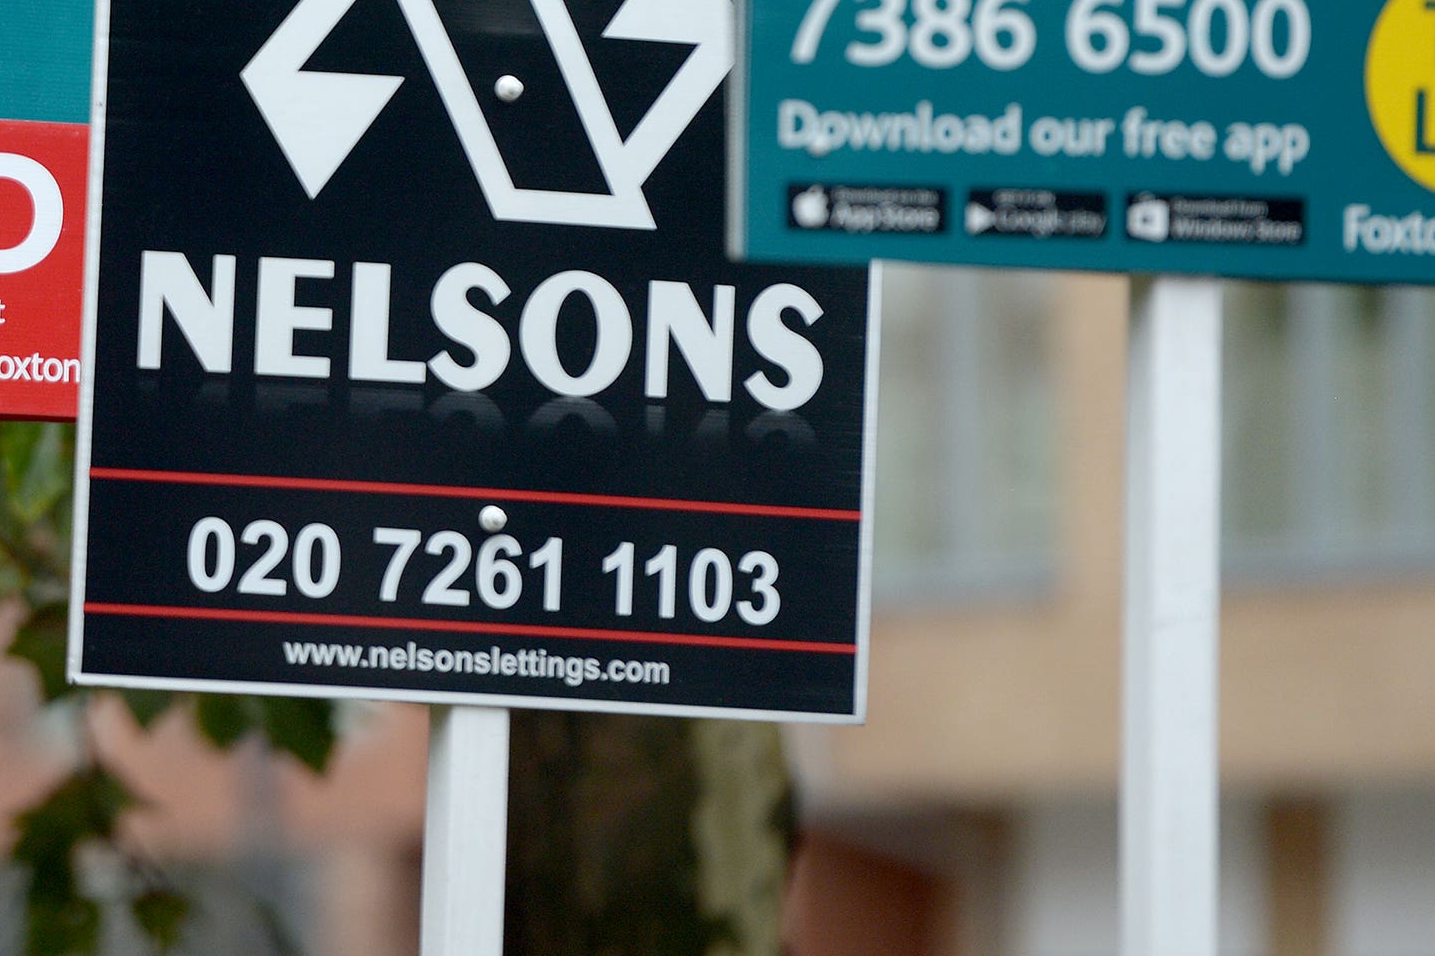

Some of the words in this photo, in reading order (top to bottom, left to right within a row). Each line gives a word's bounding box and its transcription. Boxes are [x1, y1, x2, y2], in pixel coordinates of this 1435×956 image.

[777, 98, 1023, 156] Download
[1028, 115, 1115, 157] our
[1121, 105, 1218, 161] free
[1223, 121, 1311, 176] app
[136, 249, 826, 412] NELSONS
[186, 516, 342, 599] 020
[372, 527, 563, 612] 7261
[601, 540, 782, 626] 1103
[283, 640, 671, 687] www.nelsonslettings.com
